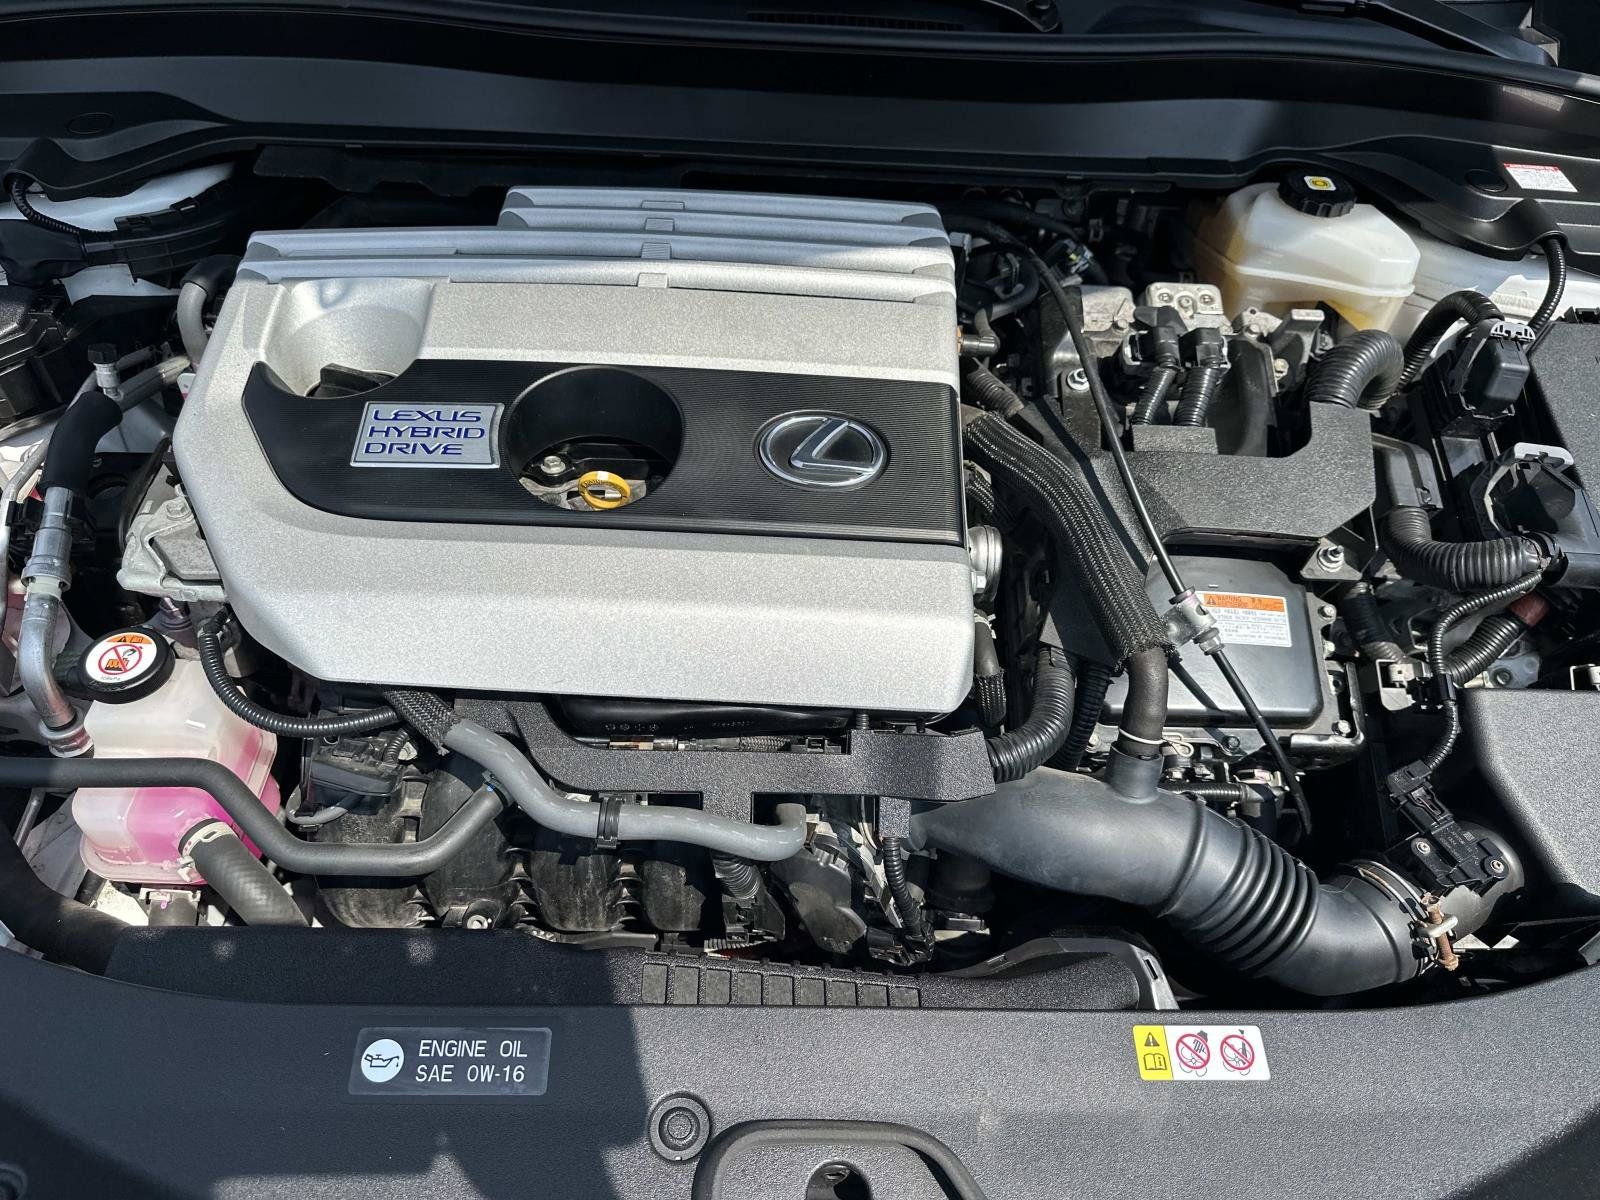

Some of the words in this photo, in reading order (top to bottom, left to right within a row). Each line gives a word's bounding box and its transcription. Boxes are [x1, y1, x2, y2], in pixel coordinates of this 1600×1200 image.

[373, 409, 482, 423] LEXUS
[368, 426, 485, 439] HYBRID
[364, 442, 464, 455] DRIVE
[418, 1039, 488, 1057] ENGINE
[499, 1039, 528, 1058] OIL
[415, 1064, 455, 1082] SAE
[466, 1064, 526, 1083] 0W-16
